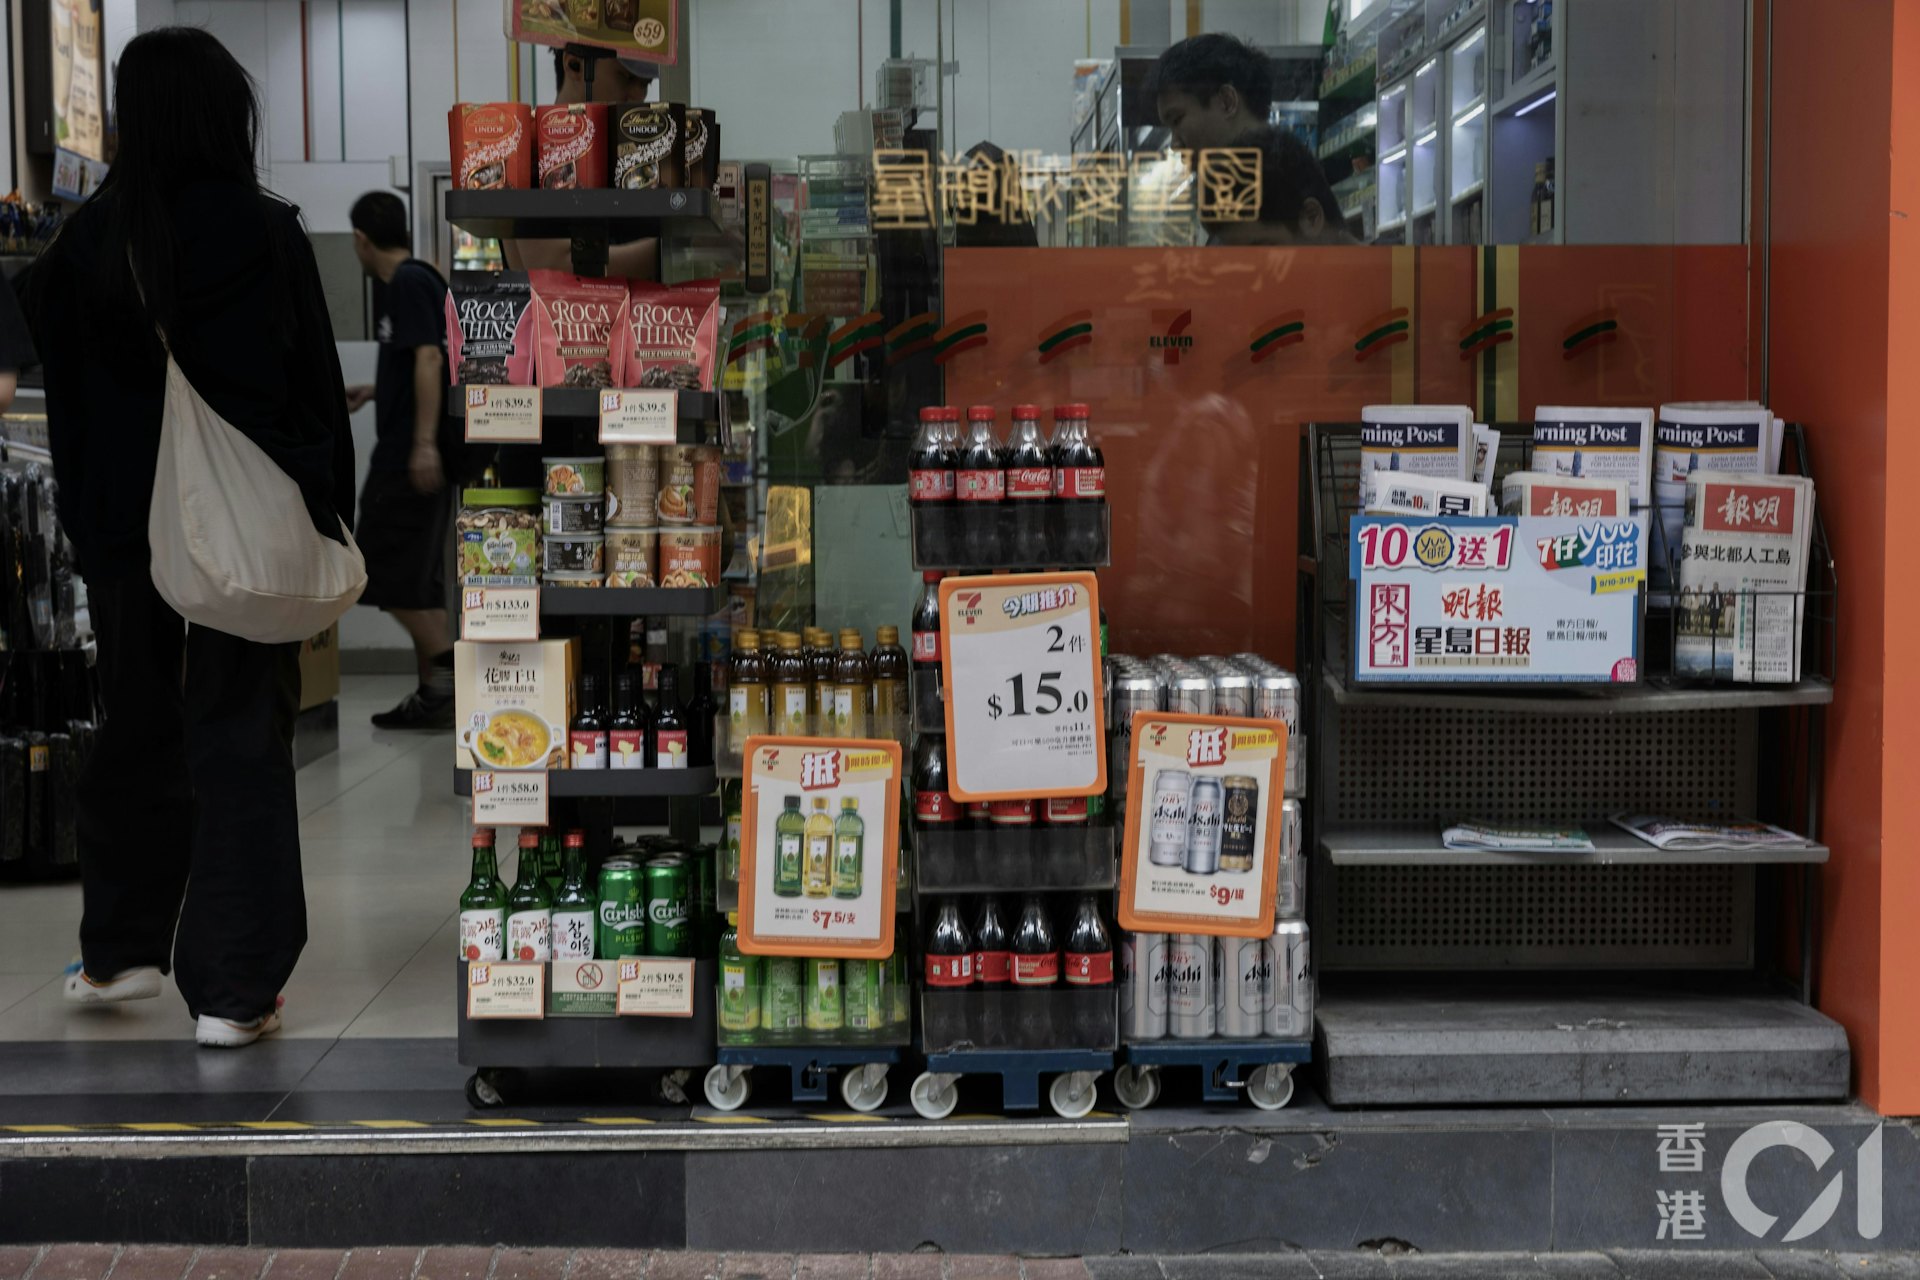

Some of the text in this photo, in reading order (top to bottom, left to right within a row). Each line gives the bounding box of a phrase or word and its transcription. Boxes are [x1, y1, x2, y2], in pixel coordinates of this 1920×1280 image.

[635, 21, 663, 39] $59
[474, 125, 504, 134] LINDOR
[548, 126, 575, 135] LINDOR
[629, 126, 658, 135] LINDOR
[460, 298, 515, 324] ROCA
[552, 299, 611, 324] ROCA
[633, 302, 693, 328] ROCA
[459, 317, 515, 342] THINS
[552, 319, 611, 343] THINS
[633, 323, 695, 347] THINS
[561, 348, 579, 356] MILK
[639, 350, 692, 359] MILK CHOCOLATE
[504, 397, 533, 409] $39.5
[638, 402, 666, 413] $39.5
[1406, 425, 1445, 443] Post
[1589, 424, 1628, 443] Post
[1706, 425, 1746, 443] Post
[1359, 524, 1409, 567] 10
[1426, 547, 1448, 561] 印花
[1457, 534, 1487, 567] 送
[1491, 526, 1512, 567] 1
[1594, 543, 1635, 568] 印花
[495, 598, 530, 611] $133.0
[1002, 584, 1077, 620] 今期推介
[1441, 583, 1503, 622] 明報
[1414, 626, 1531, 655] 星島日報
[1546, 630, 1609, 642] 星島日報/明報
[987, 670, 1089, 721] $15.0
[1186, 727, 1228, 768] 抵
[800, 749, 841, 792] 抵
[510, 782, 539, 794] $58.0
[1188, 811, 1221, 827] Asahi
[568, 918, 585, 940] 참
[570, 934, 591, 957] 이슬
[506, 975, 534, 987] $32.0
[655, 971, 684, 983] $19.5
